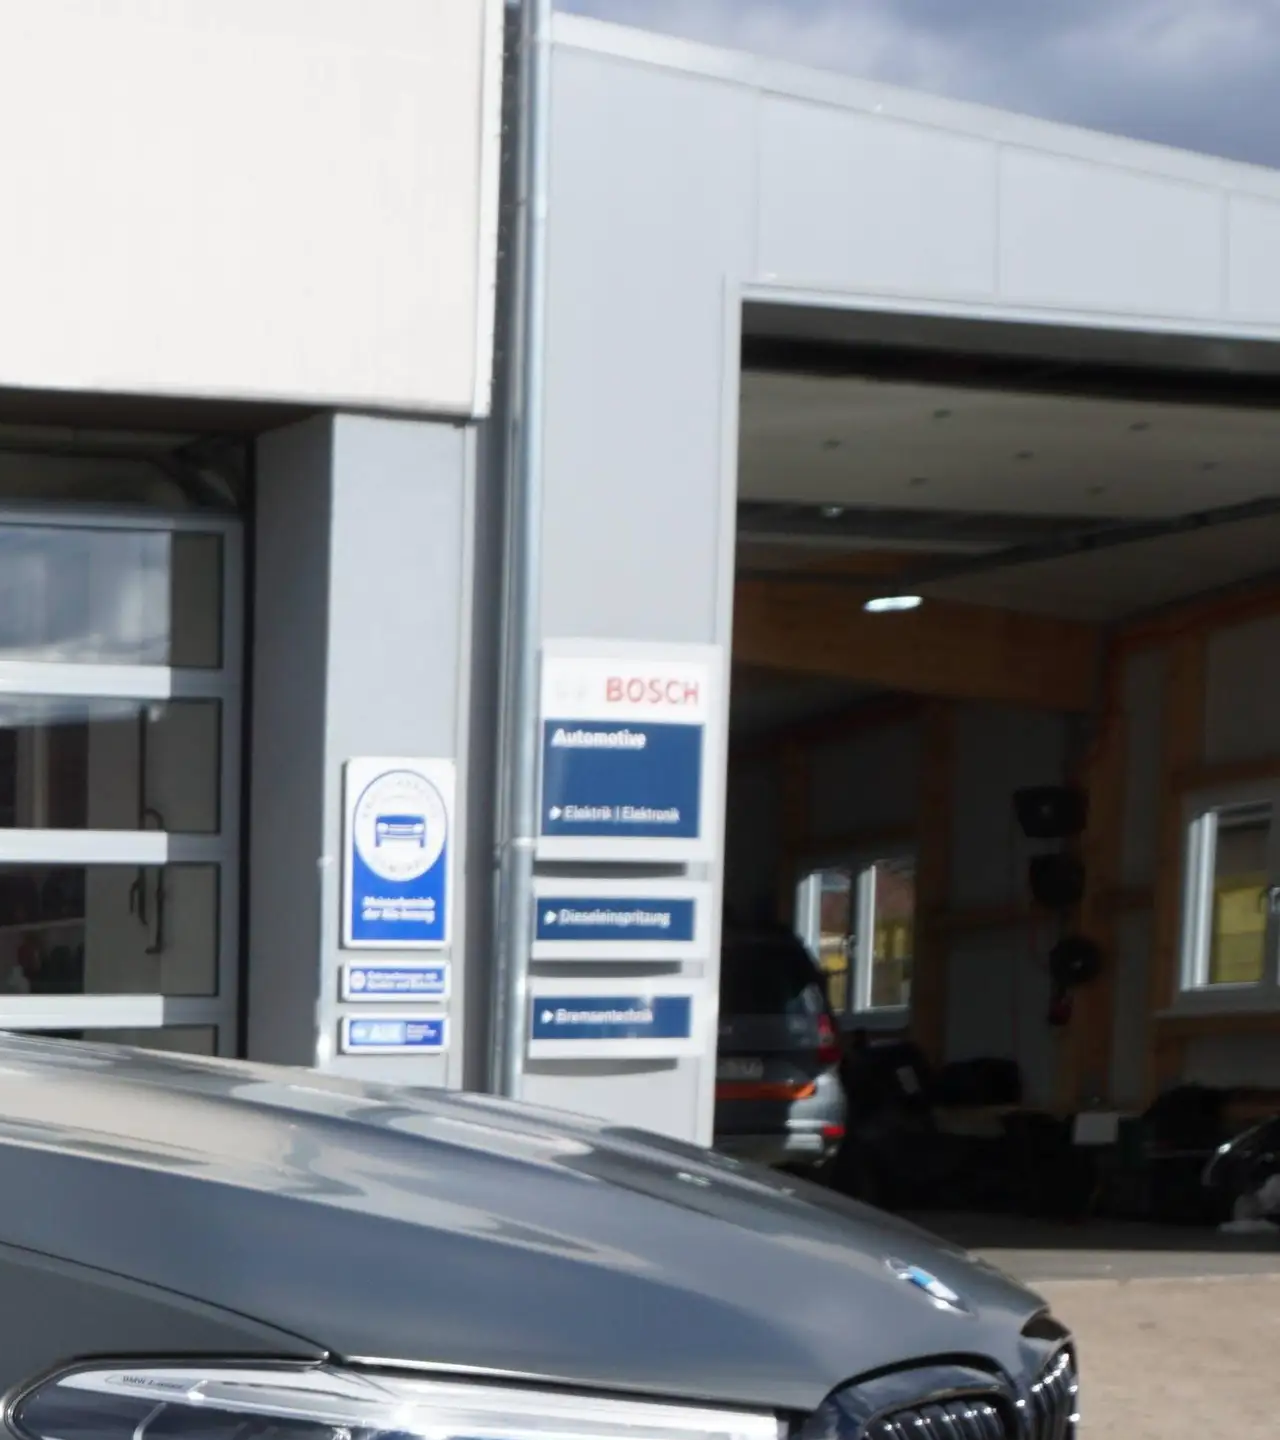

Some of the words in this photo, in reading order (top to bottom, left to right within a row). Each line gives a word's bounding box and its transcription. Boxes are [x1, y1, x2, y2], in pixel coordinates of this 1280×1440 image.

[606, 675, 700, 705] BOSCH
[551, 728, 647, 750] Automotive
[563, 805, 613, 822] Elektrik
[621, 806, 681, 824] Elektronik
